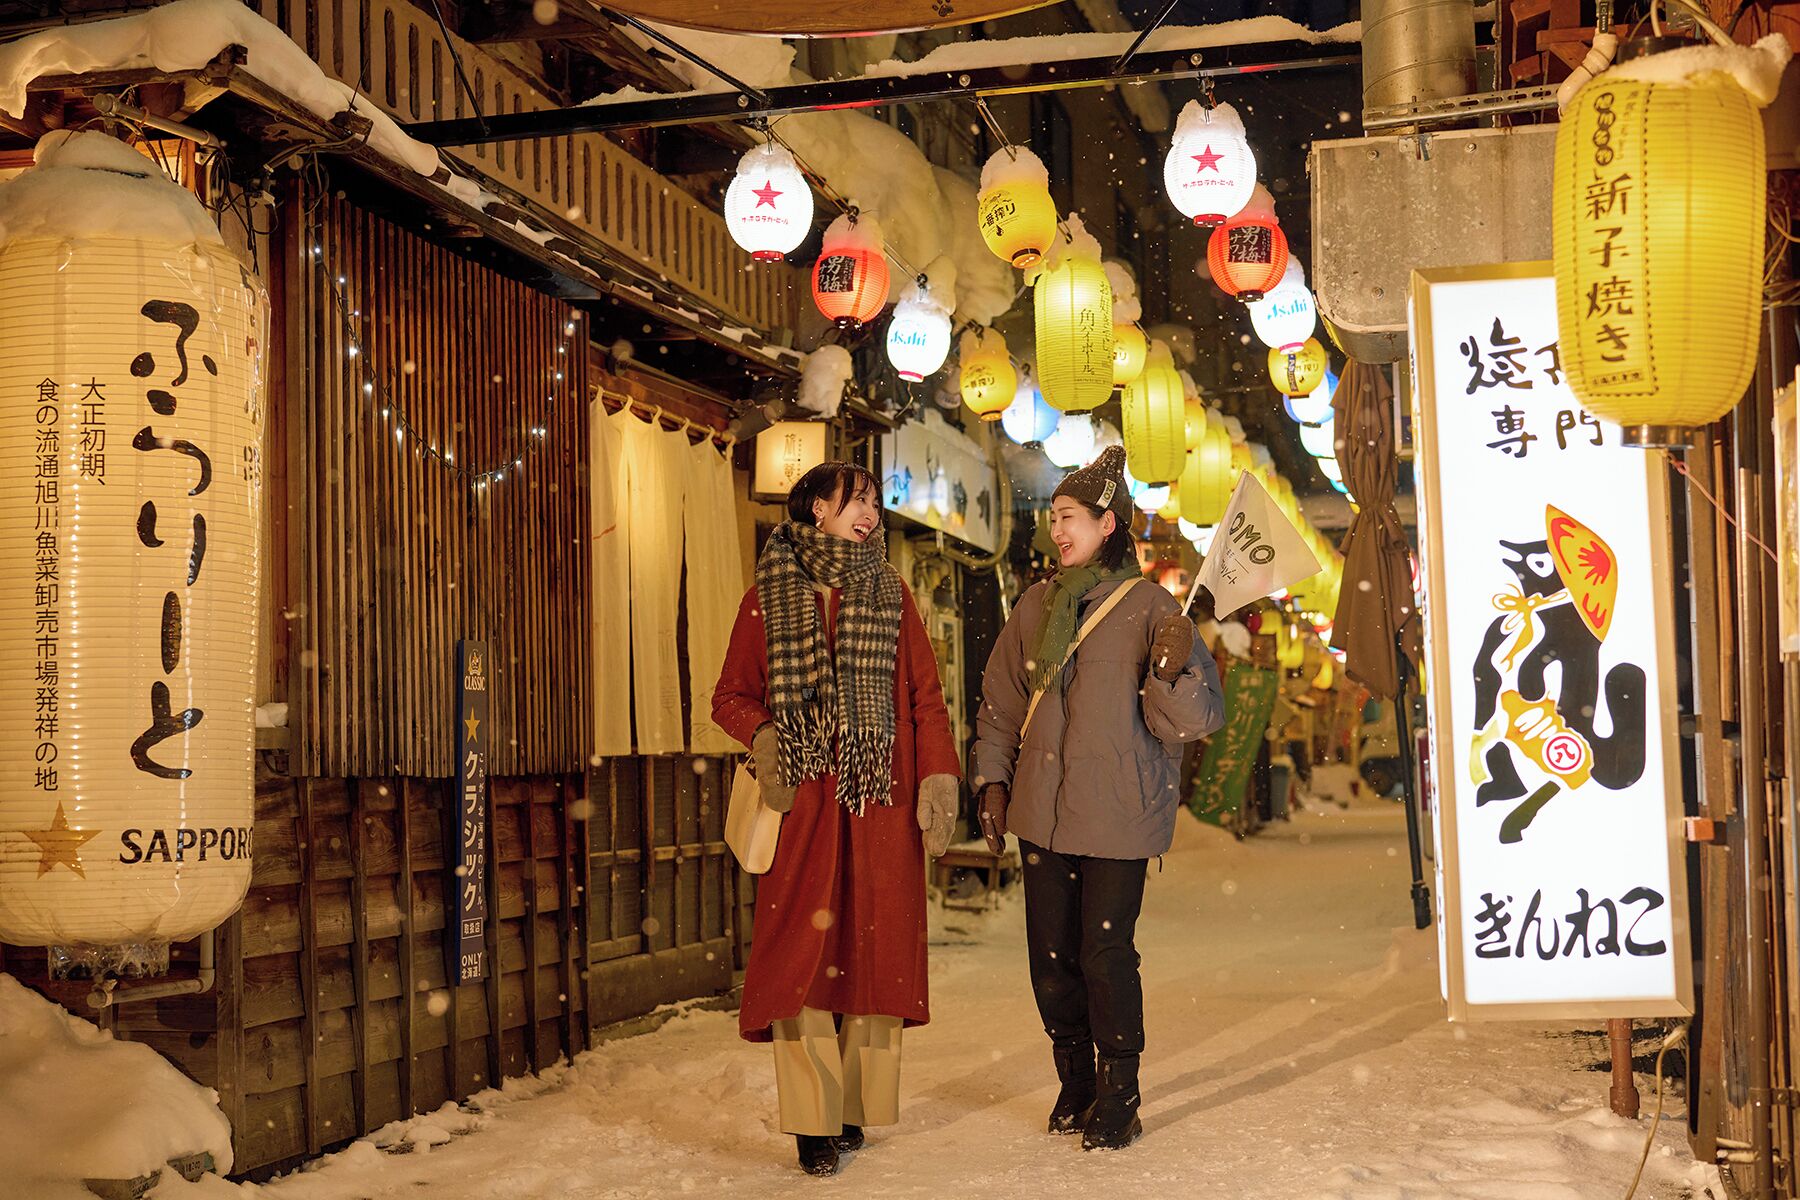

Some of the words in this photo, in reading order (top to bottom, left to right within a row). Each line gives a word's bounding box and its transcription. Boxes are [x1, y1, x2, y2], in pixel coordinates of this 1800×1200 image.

[1585, 169, 1635, 362] 新子焼き
[80, 377, 106, 486] 大正初期、
[1486, 404, 1603, 458] 専門
[34, 377, 60, 792] 食の流通旭川魚菜卸売市場発祥の地
[130, 299, 218, 780] ふらりーと
[1229, 512, 1276, 565] OMO
[464, 675, 486, 691] CLASSIC
[463, 750, 478, 912] クラシック
[1474, 886, 1667, 961] ぎんねこ
